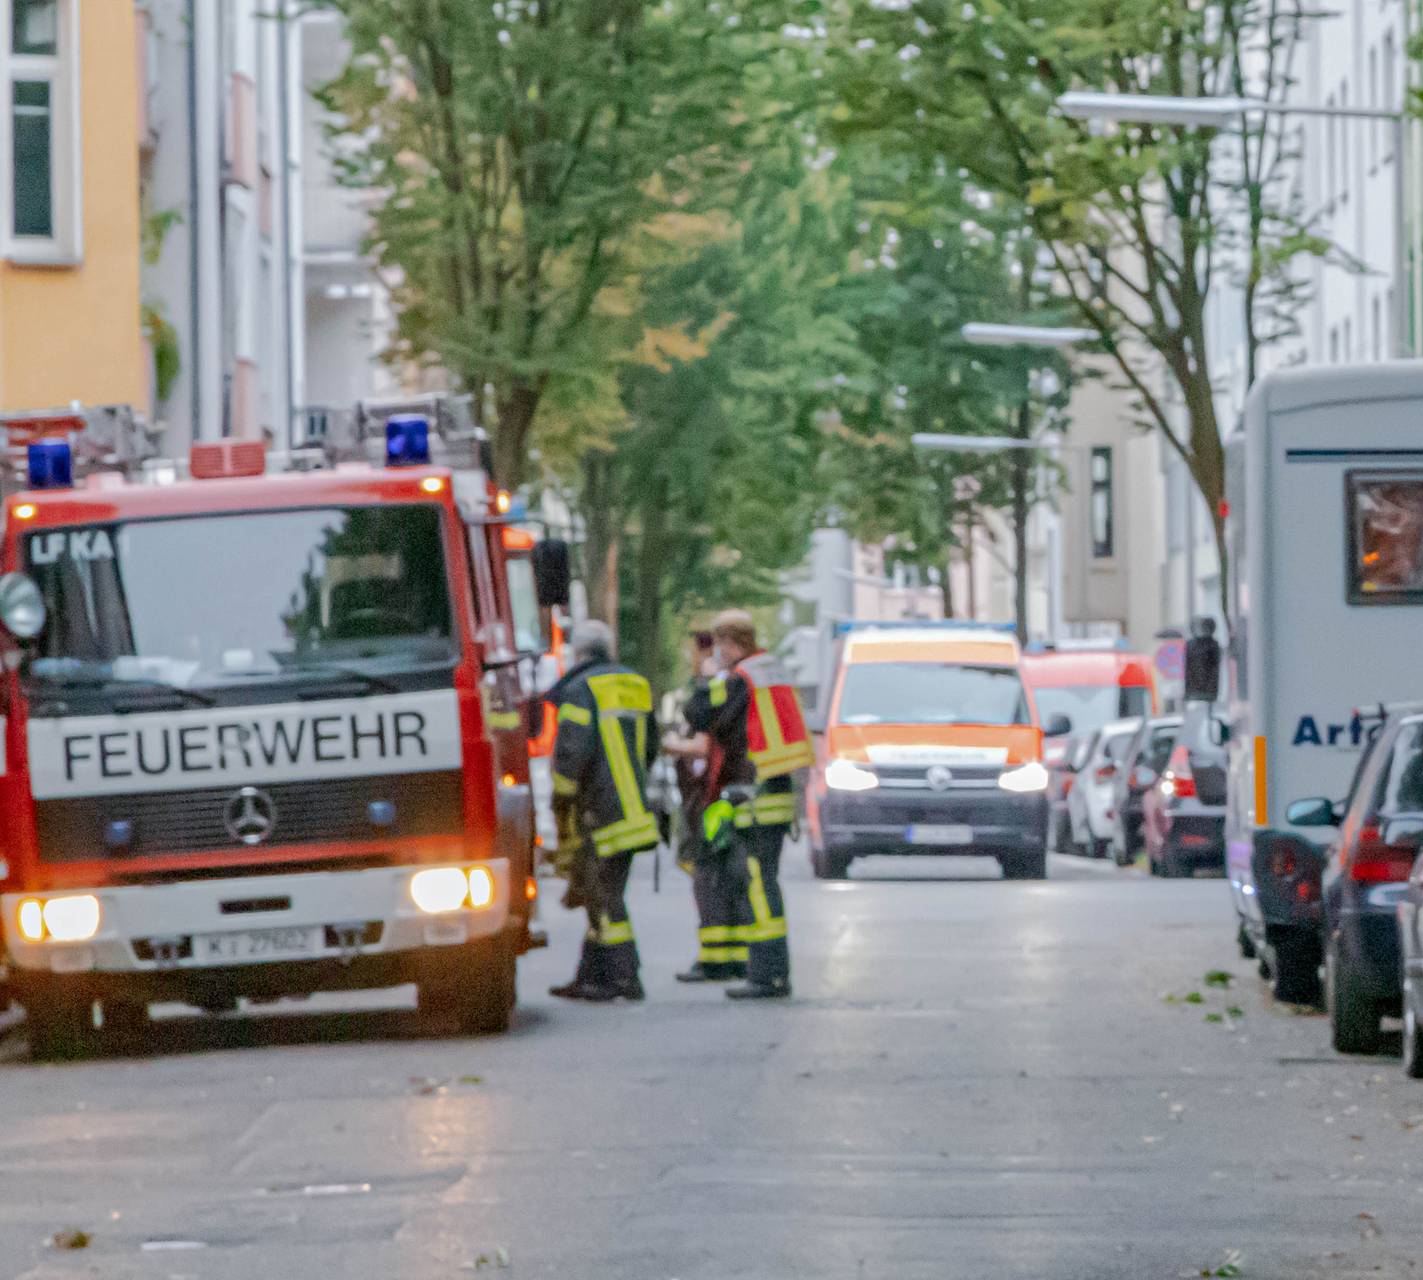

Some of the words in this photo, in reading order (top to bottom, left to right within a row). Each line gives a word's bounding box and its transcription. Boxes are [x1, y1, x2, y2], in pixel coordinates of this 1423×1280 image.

[31, 532, 66, 565] LF
[70, 530, 115, 560] KA
[63, 711, 429, 781] FEUERWEHR
